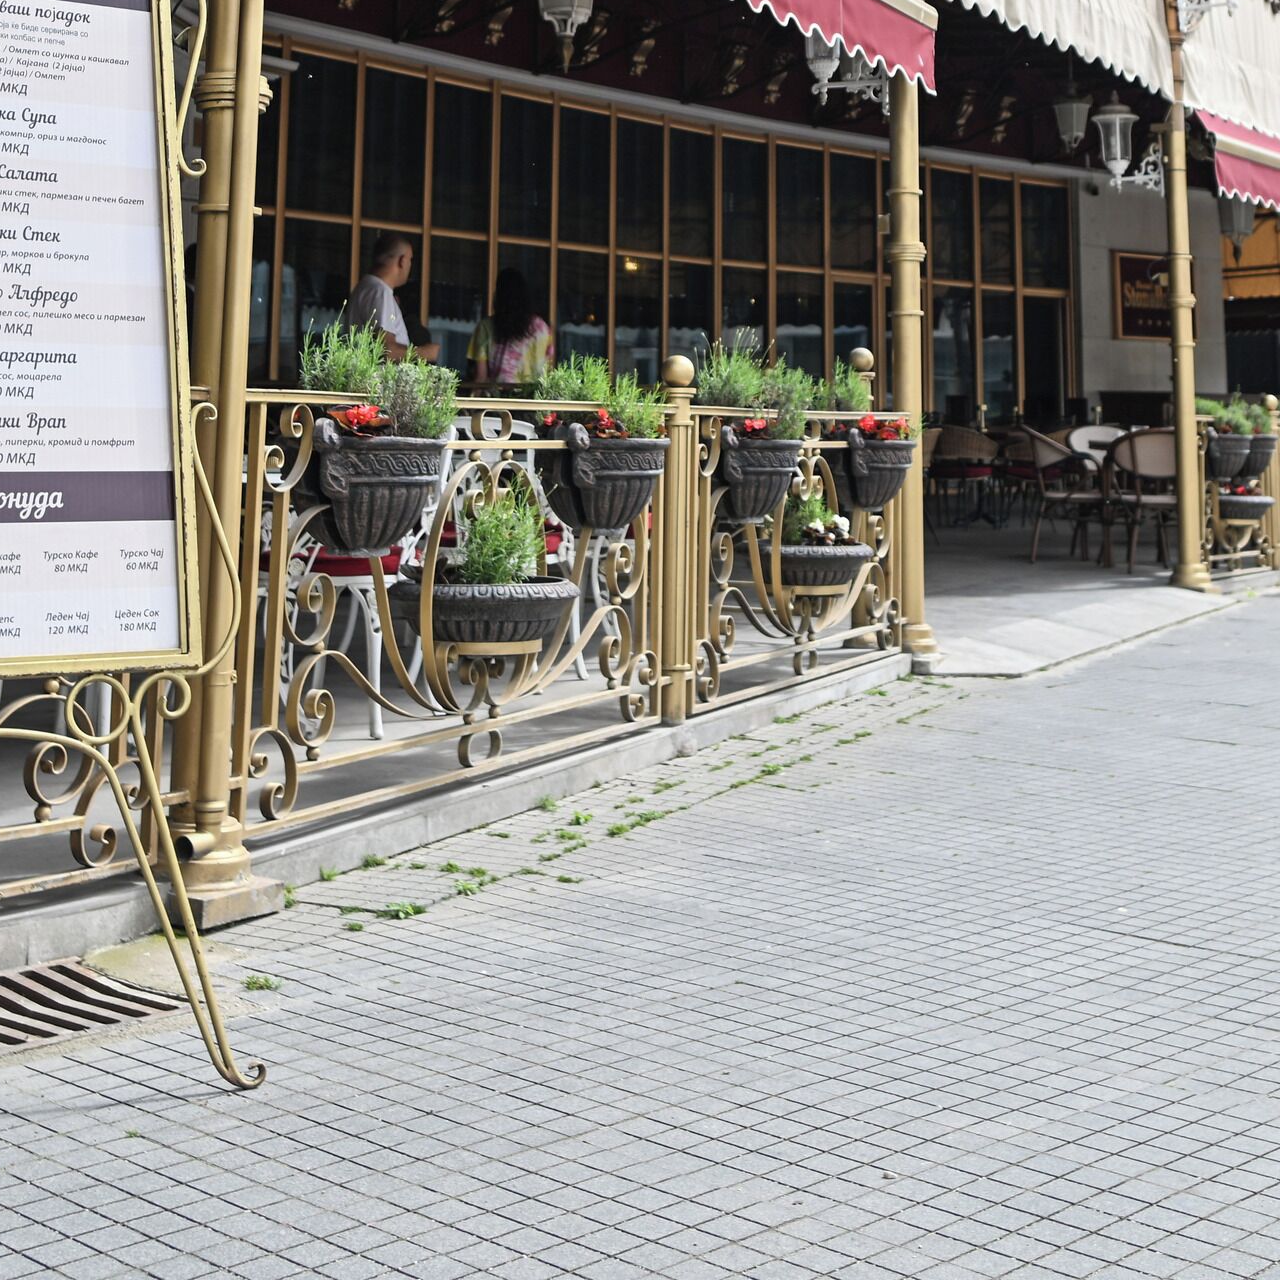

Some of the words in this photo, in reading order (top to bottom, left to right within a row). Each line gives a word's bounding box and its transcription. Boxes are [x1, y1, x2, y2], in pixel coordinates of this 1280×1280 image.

[34, 7, 90, 27] појадок
[8, 45, 40, 56] Омлет
[51, 51, 80, 60] шунка
[87, 56, 129, 66] кашкавал
[16, 57, 49, 68] Кајгана
[52, 61, 61, 70] (2
[60, 62, 86, 73] јајца)
[2, 67, 28, 78] јајца)
[34, 70, 66, 81] Омлет
[0, 81, 28, 97] МКД
[21, 107, 57, 128] Супа
[0, 130, 35, 140] компир,
[36, 133, 58, 141] ориз
[65, 135, 107, 145] магдонос
[0, 141, 30, 157] МКД
[14, 190, 39, 199] стек,
[40, 192, 84, 201] пармезан
[91, 195, 117, 203] печен
[117, 195, 145, 206] багет
[0, 201, 30, 216] МКД
[22, 225, 61, 243] Стек
[10, 250, 44, 259] морков
[52, 250, 90, 262] брокула
[2, 262, 31, 276] МКД
[7, 283, 78, 309] Алфредо
[13, 310, 31, 319] сос,
[32, 311, 73, 319] пилешко
[73, 312, 95, 320] месо
[103, 314, 146, 323] пармезан
[3, 322, 33, 337] МКД
[16, 373, 62, 383] моцарела
[4, 386, 34, 400] МКД
[26, 411, 67, 435] Врап
[4, 439, 46, 448] пиперки,
[47, 437, 83, 448] кромид
[90, 437, 135, 448] помфрит
[5, 452, 36, 466] МКД
[43, 550, 74, 562] Турско
[74, 549, 99, 560] Кафе
[119, 548, 149, 560] Турско
[150, 548, 164, 559] Чај
[0, 564, 21, 575] МКД
[53, 563, 66, 573] 80
[66, 562, 88, 573] МКД
[125, 561, 137, 571] 60
[137, 560, 158, 571] МКД
[44, 611, 74, 622] Леден
[75, 610, 90, 622] Чај
[114, 608, 142, 620] Цеден
[143, 608, 160, 618] Сок
[48, 625, 64, 635] 120
[67, 624, 89, 635] МКД
[119, 622, 135, 632] 180
[135, 621, 157, 632] МКД
